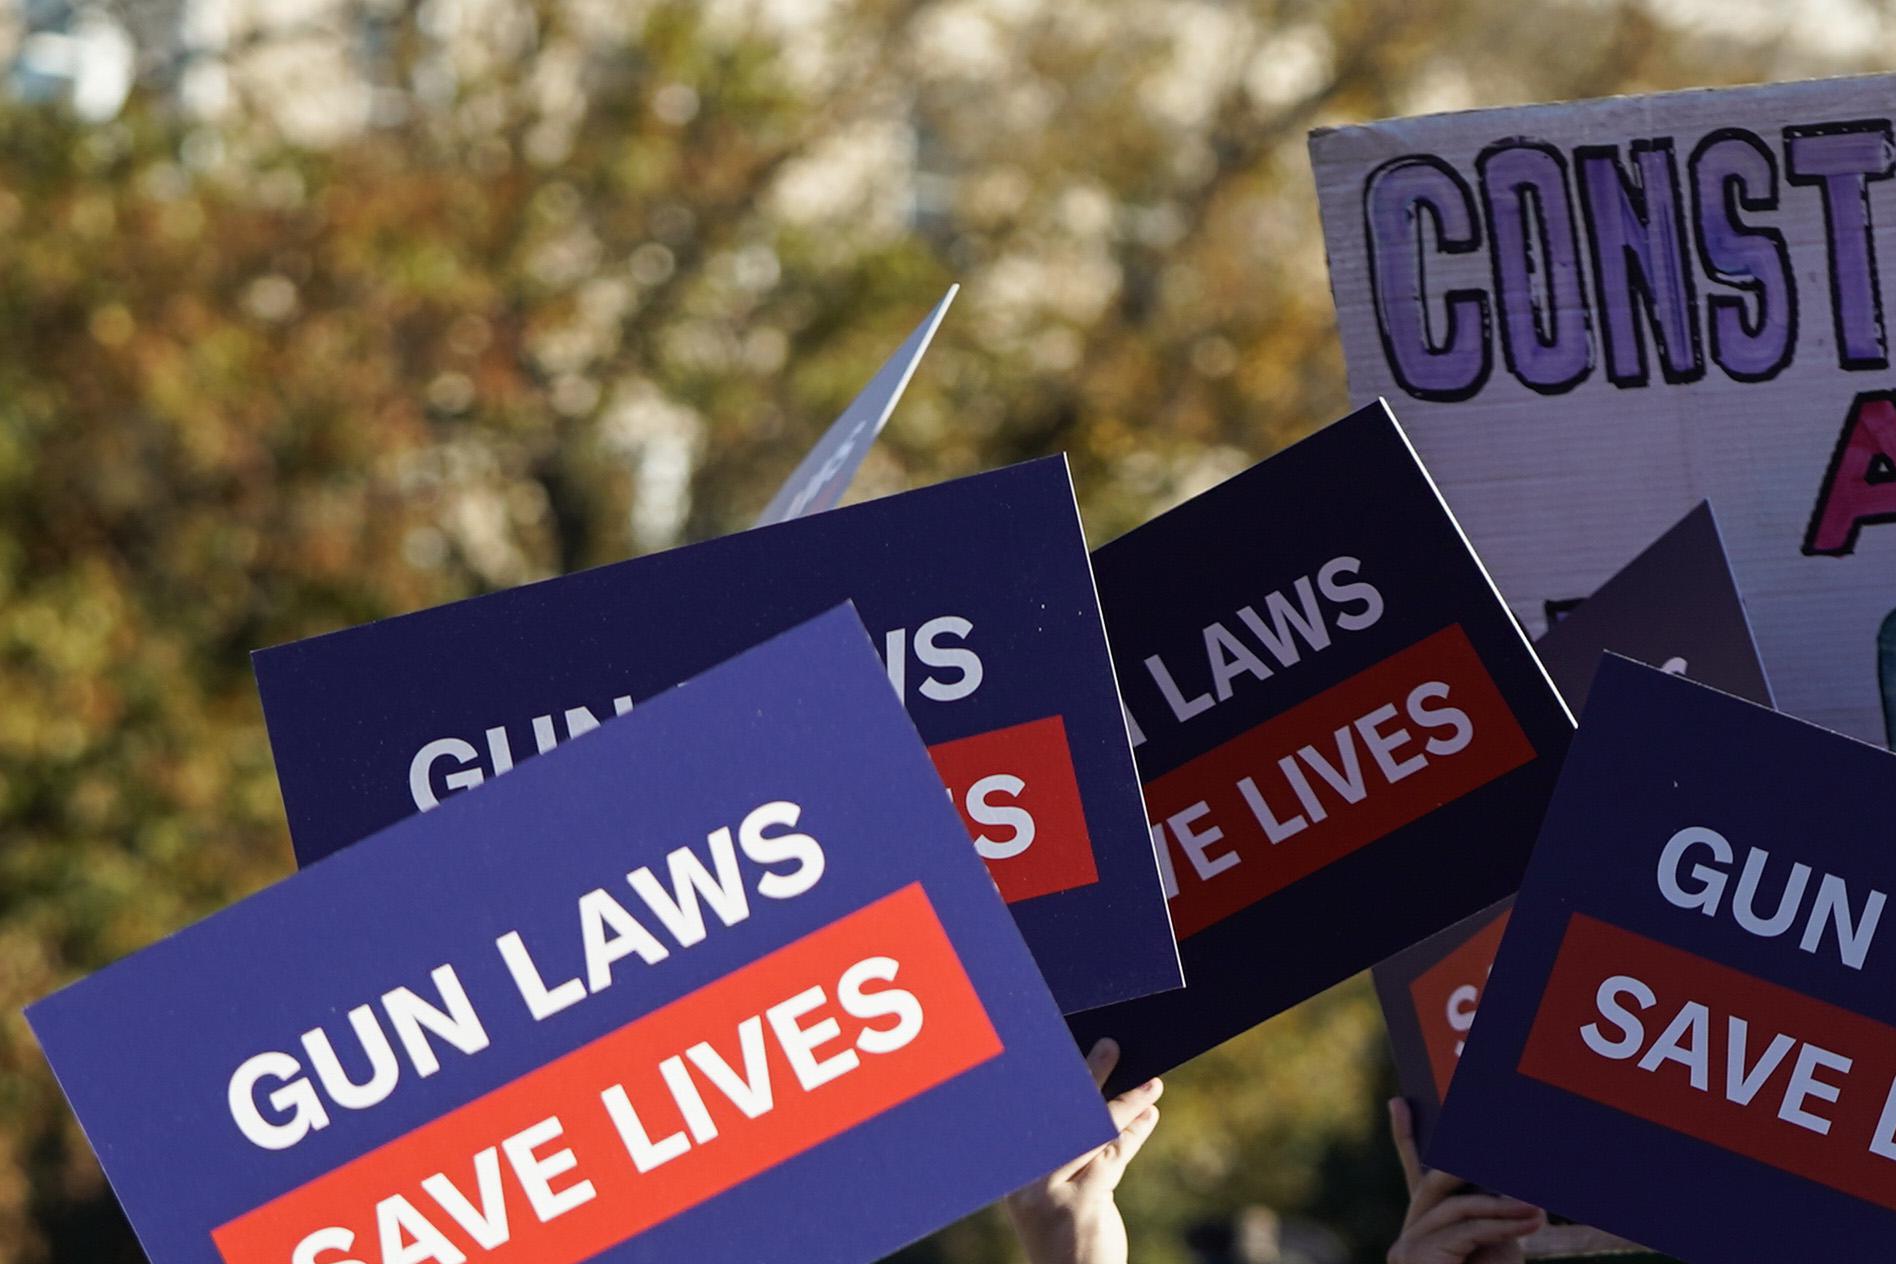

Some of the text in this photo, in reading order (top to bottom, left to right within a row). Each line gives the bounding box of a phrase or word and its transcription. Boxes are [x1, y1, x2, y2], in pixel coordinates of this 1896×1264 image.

[1143, 556, 1385, 724] LAWS
[1236, 681, 1474, 845] LIVES
[227, 964, 490, 1150] GUN
[496, 801, 827, 1021] LAWS
[1657, 826, 1888, 971] GUN
[601, 956, 924, 1174] LIVES
[1579, 975, 1854, 1136] SAVE
